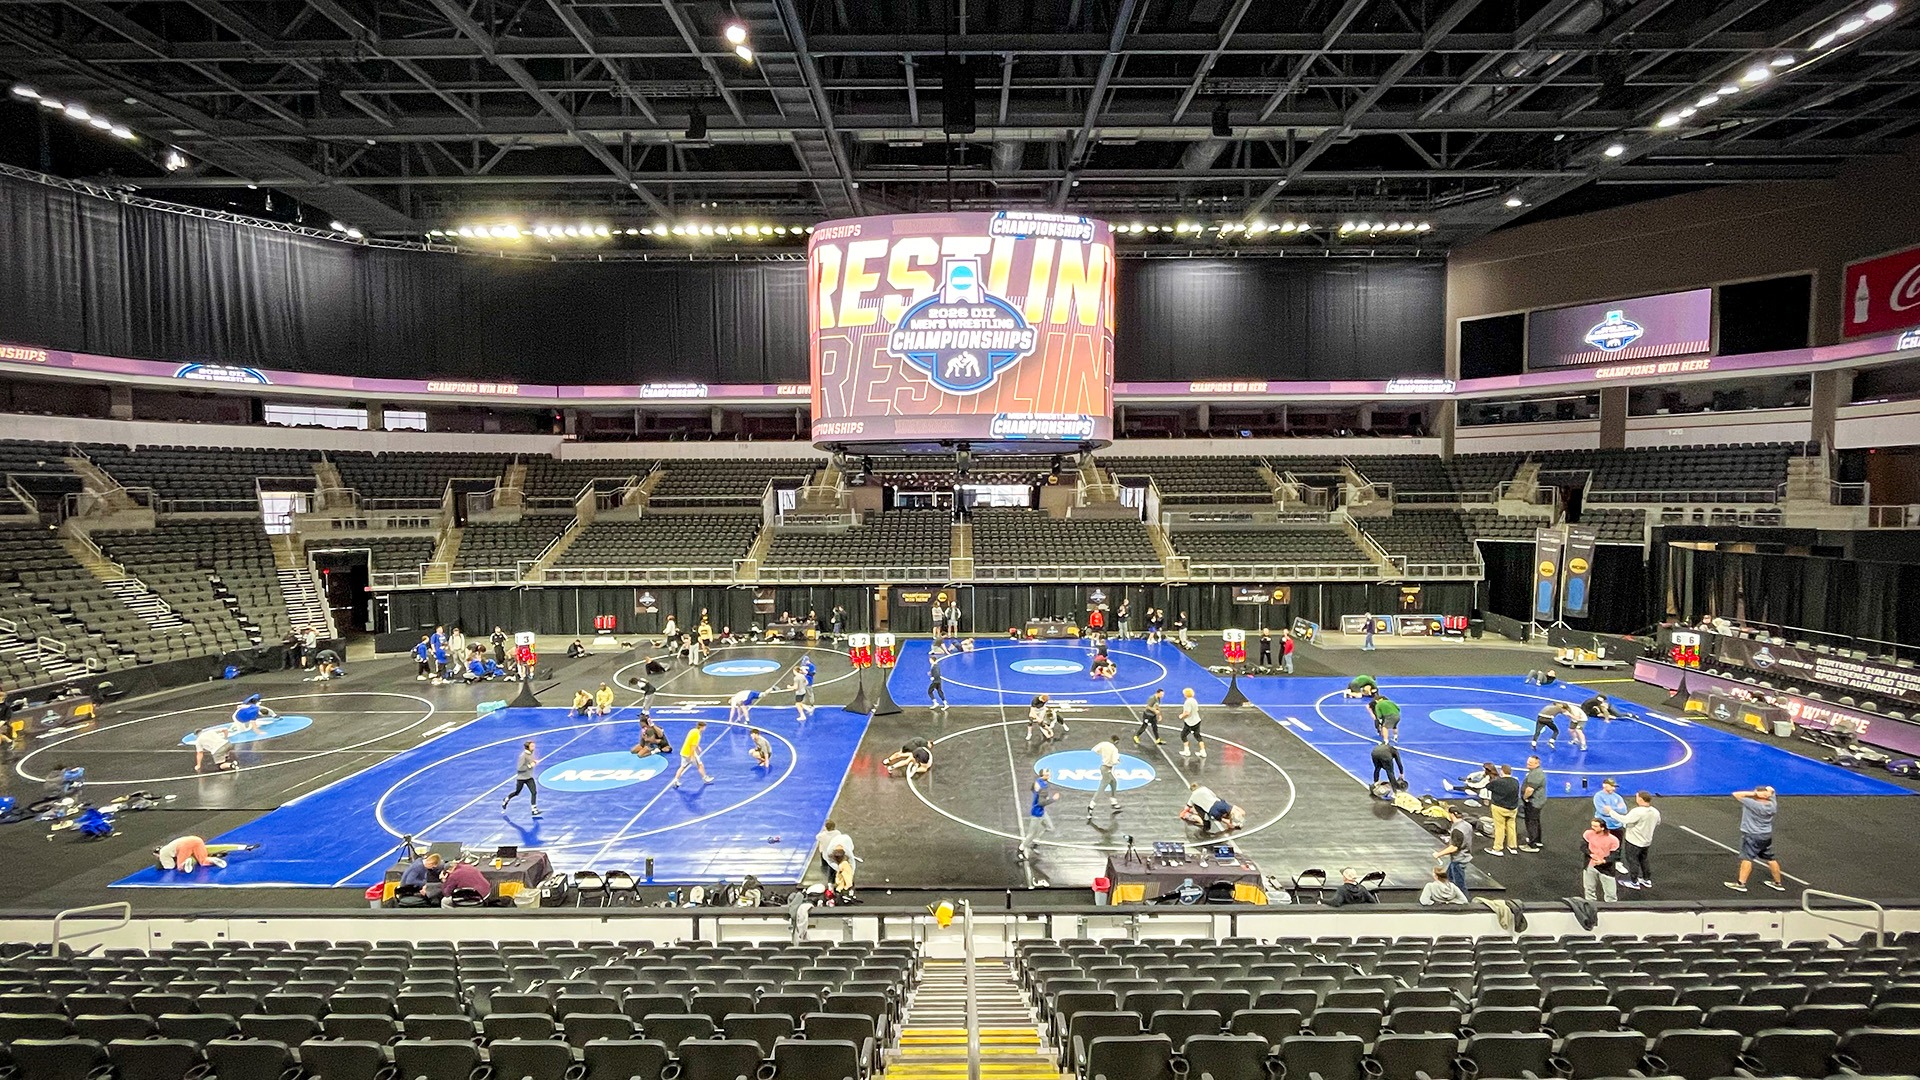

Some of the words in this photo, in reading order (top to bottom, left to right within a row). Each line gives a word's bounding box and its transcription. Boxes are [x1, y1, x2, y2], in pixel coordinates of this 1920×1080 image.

[993, 220, 1092, 239] CHAMPIONSHIPS
[928, 307, 969, 319] 2026
[910, 318, 947, 330] MEN'S
[948, 318, 1015, 330] WRESTLING
[893, 330, 1033, 351] CHAMPIONSHIPS
[1595, 363, 1657, 379] CHAMPIONS
[1658, 361, 1680, 374] WIN
[1680, 359, 1711, 372] HERE
[427, 381, 479, 393] CHAMPIONS
[479, 384, 497, 394] WIN
[497, 384, 519, 395] HERE
[994, 419, 1092, 435] CHAMPIONSHIPS
[1779, 658, 1804, 668] HOSTED
[1816, 657, 1864, 673] NORTHERN
[1864, 666, 1886, 676] SUN
[1815, 665, 1873, 682] CONFERENCE
[1873, 676, 1895, 686] AND
[1815, 672, 1849, 685] SPORTS
[1849, 679, 1907, 696] AUTHORITY
[548, 769, 656, 782] NCAA
